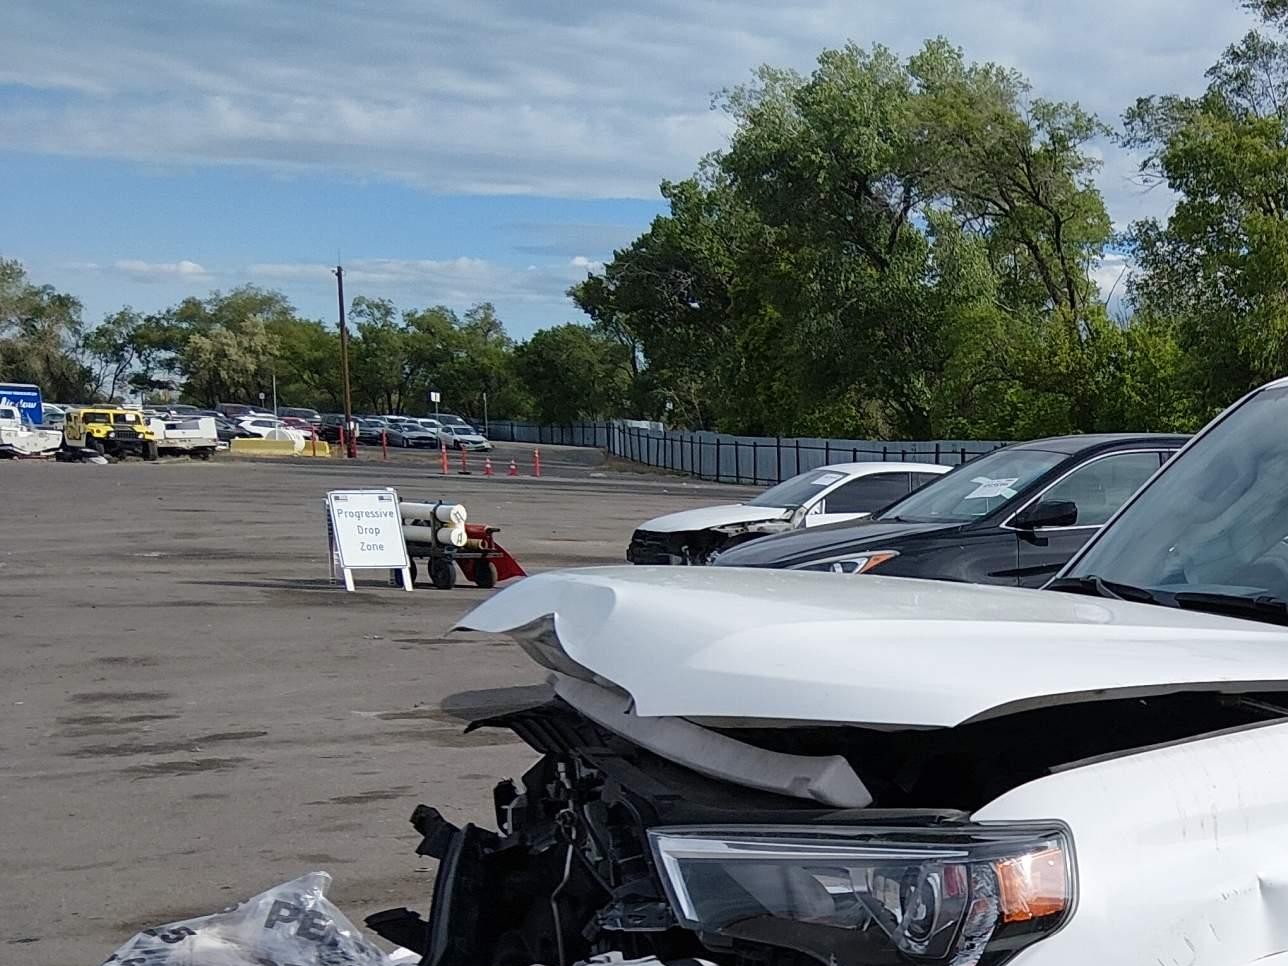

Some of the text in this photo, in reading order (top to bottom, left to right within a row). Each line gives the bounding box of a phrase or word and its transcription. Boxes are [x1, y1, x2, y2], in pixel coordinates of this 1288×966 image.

[336, 508, 394, 520] Progressive
[356, 525, 381, 536] Drop
[360, 541, 385, 552] Zone
